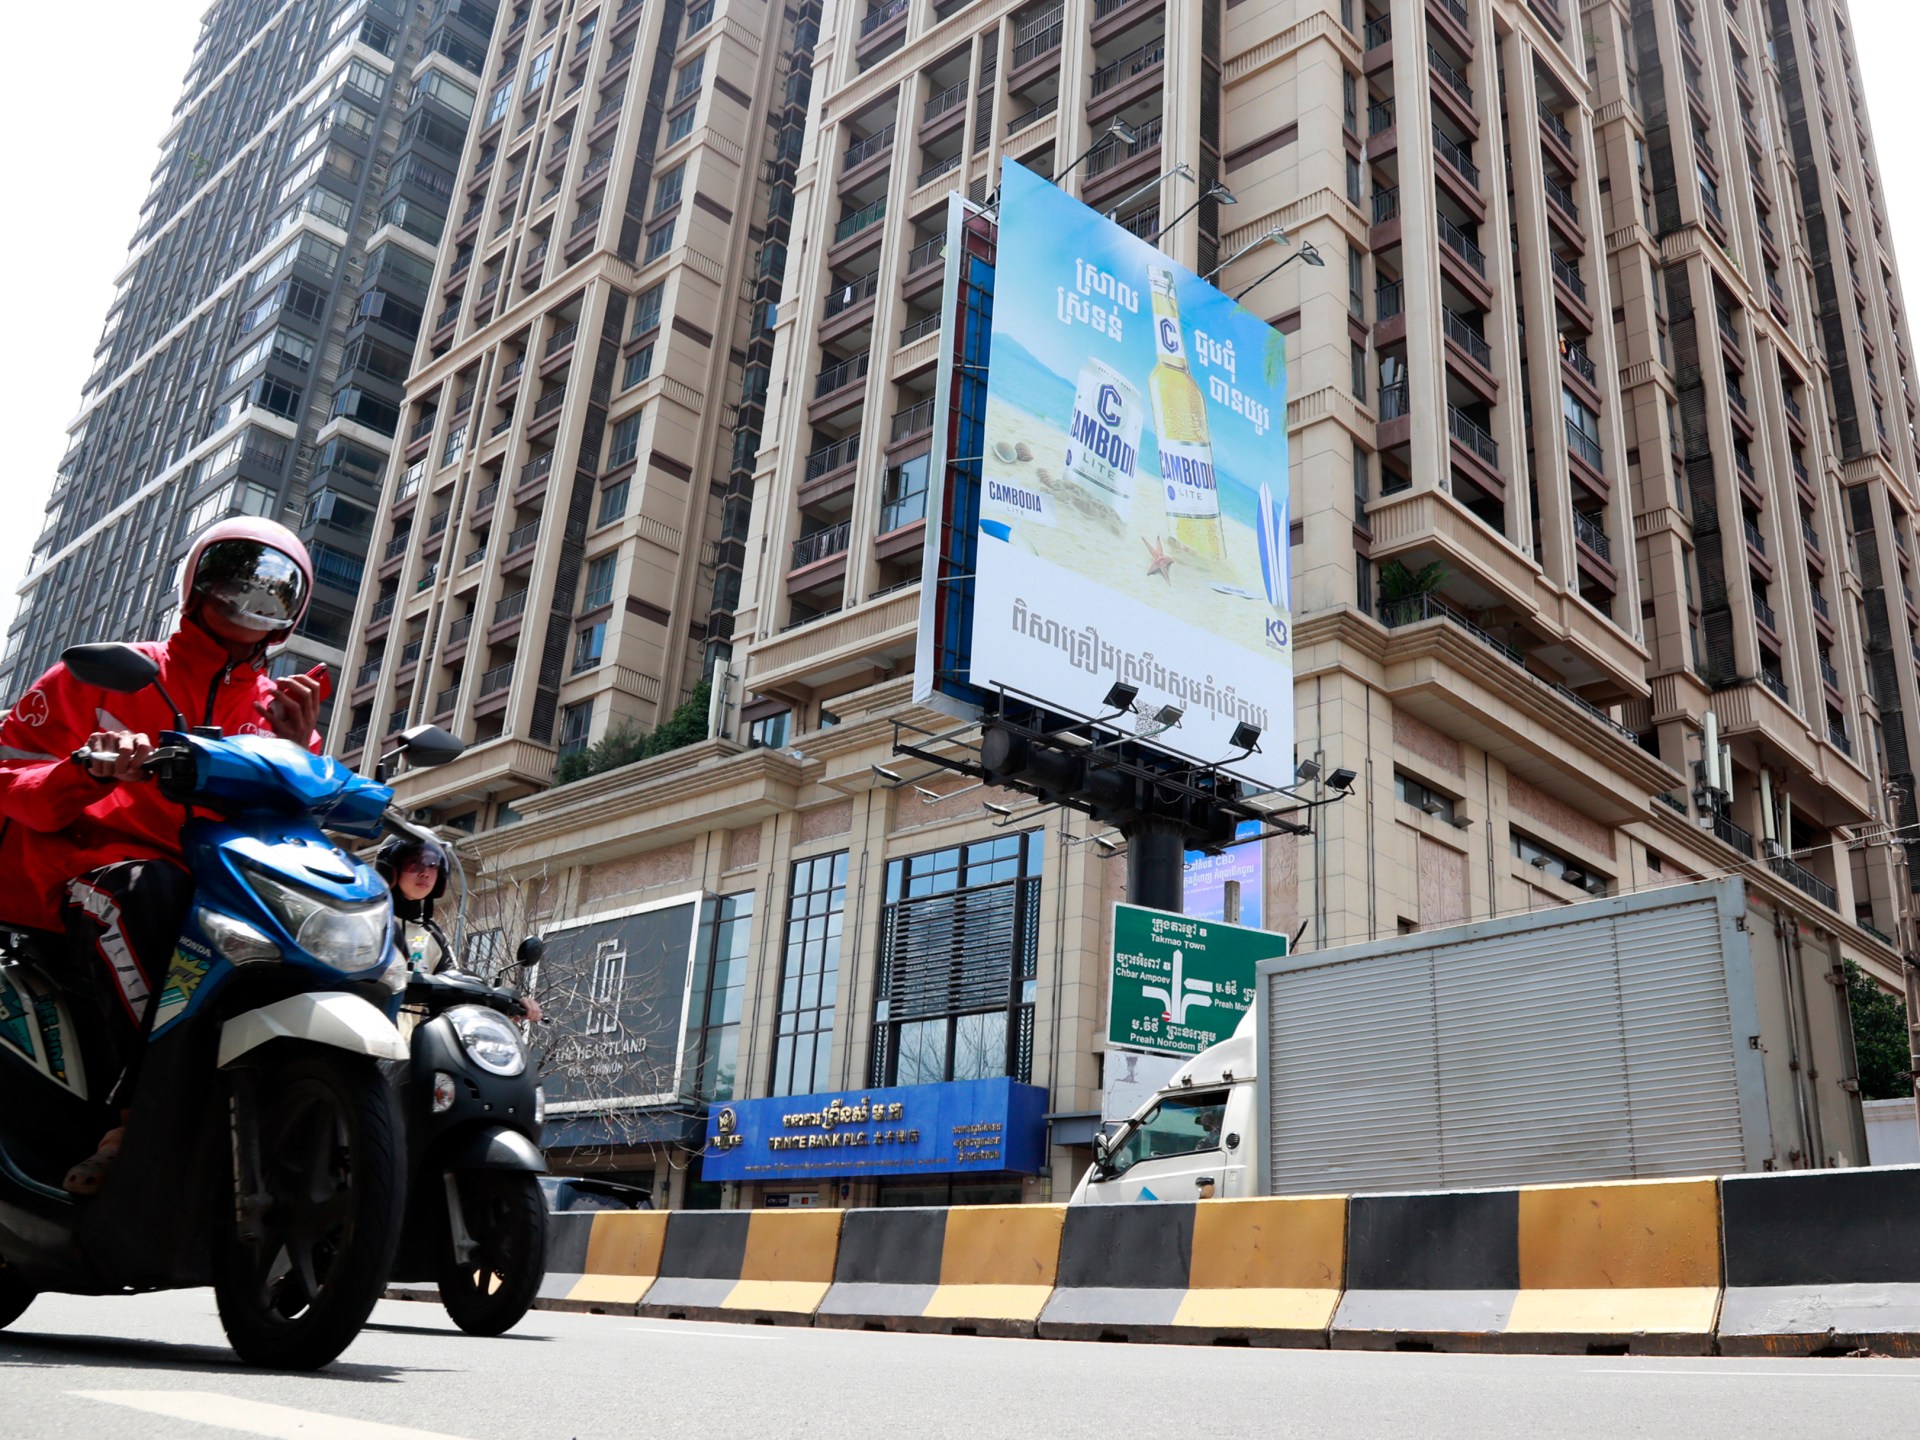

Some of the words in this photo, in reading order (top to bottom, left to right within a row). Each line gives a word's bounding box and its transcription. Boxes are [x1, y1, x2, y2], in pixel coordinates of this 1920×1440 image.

[1070, 406, 1138, 479] AMBODI
[1082, 451, 1117, 481] LITE
[989, 480, 1042, 513] CAMBODIA
[1178, 487, 1203, 501] LITE
[1215, 854, 1235, 866] CBD
[179, 935, 213, 958] HONDA
[1151, 933, 1182, 946] Takmao
[1184, 940, 1206, 951] Town
[1115, 967, 1139, 979] Chbar
[1140, 971, 1171, 985] Ampoev
[1214, 999, 1234, 1010] Preah
[577, 1037, 647, 1060] HEARTLAND
[1130, 1032, 1155, 1045] Preah
[1156, 1038, 1196, 1052] Norodom
[769, 1134, 806, 1151] PRINCE
[808, 1132, 843, 1148] BANK
